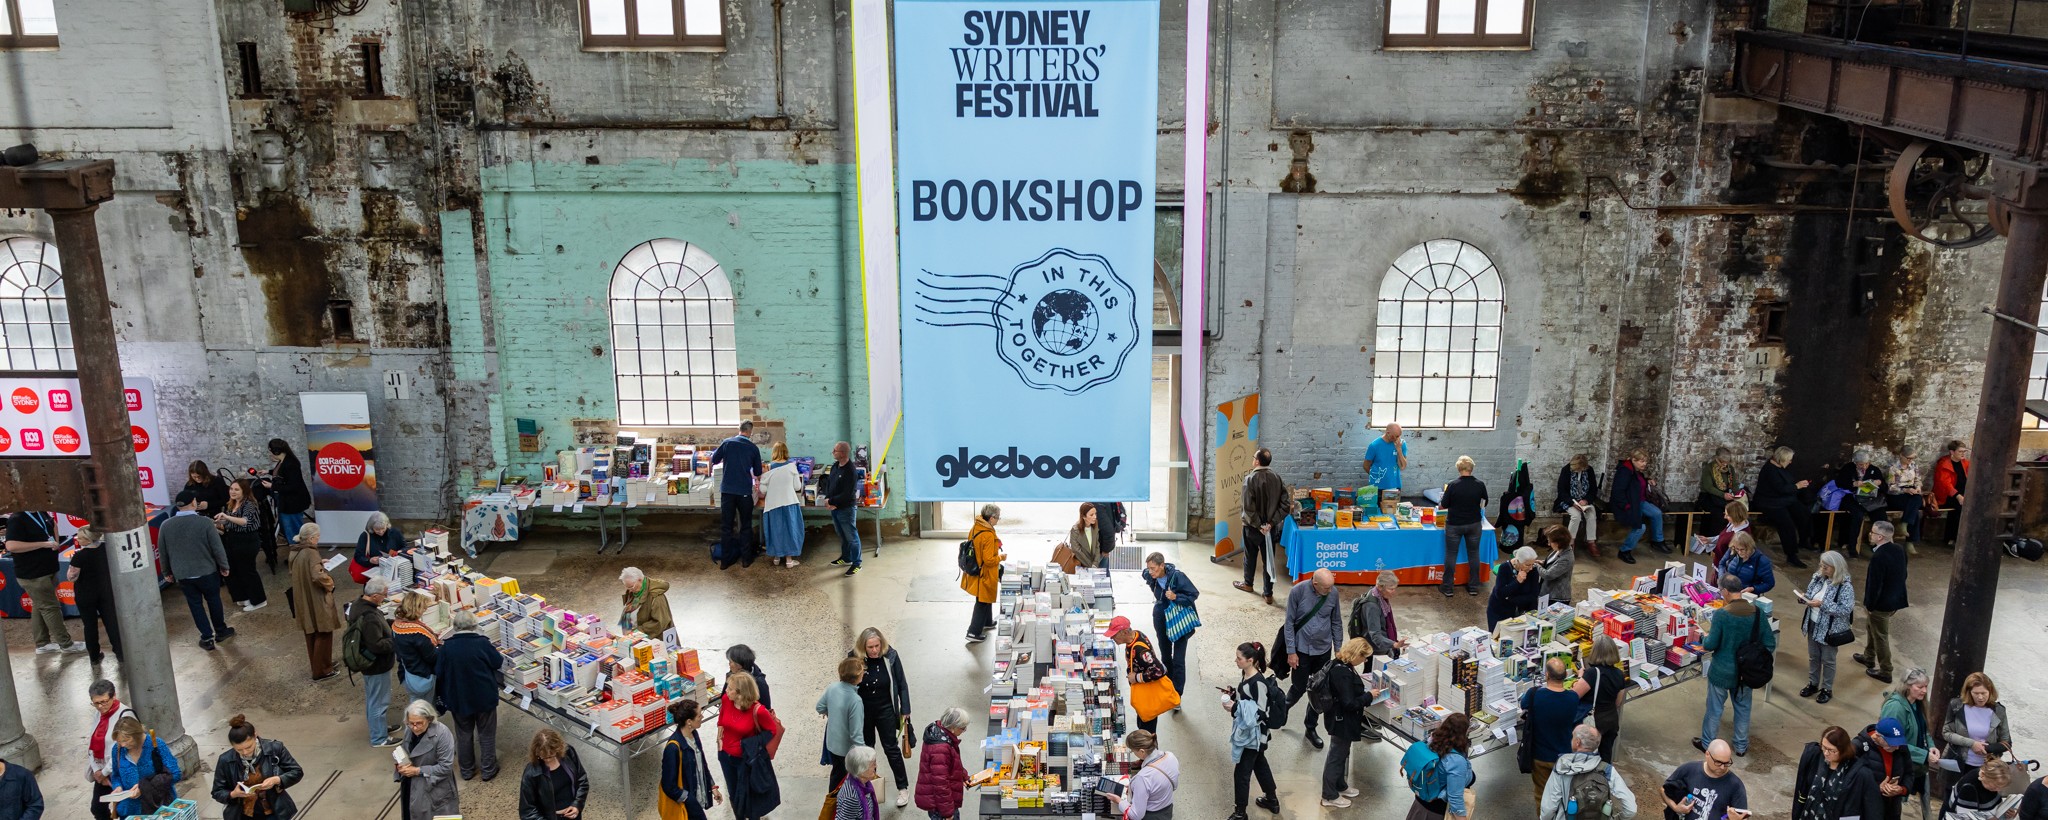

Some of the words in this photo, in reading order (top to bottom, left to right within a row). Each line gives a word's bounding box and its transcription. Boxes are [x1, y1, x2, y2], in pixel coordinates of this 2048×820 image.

[963, 10, 1091, 46] SYDNEY
[955, 83, 1099, 118] FESTIVAL
[912, 179, 1143, 222] BOOKSHOP
[1042, 266, 1064, 284] IN
[1079, 268, 1119, 310] THIS
[1009, 319, 1105, 379] TOGETHER
[329, 457, 351, 465] Radio
[320, 464, 362, 475] SYDNEY
[936, 446, 1121, 488] gleebooks
[121, 531, 141, 552] J1
[1316, 542, 1359, 553] Reading
[131, 550, 144, 569] 2
[1316, 552, 1349, 560] opens
[1316, 559, 1346, 568] doors
[1696, 568, 1703, 578] K
[595, 627, 602, 635] P
[666, 634, 674, 643] O
[1453, 636, 1460, 646] H
